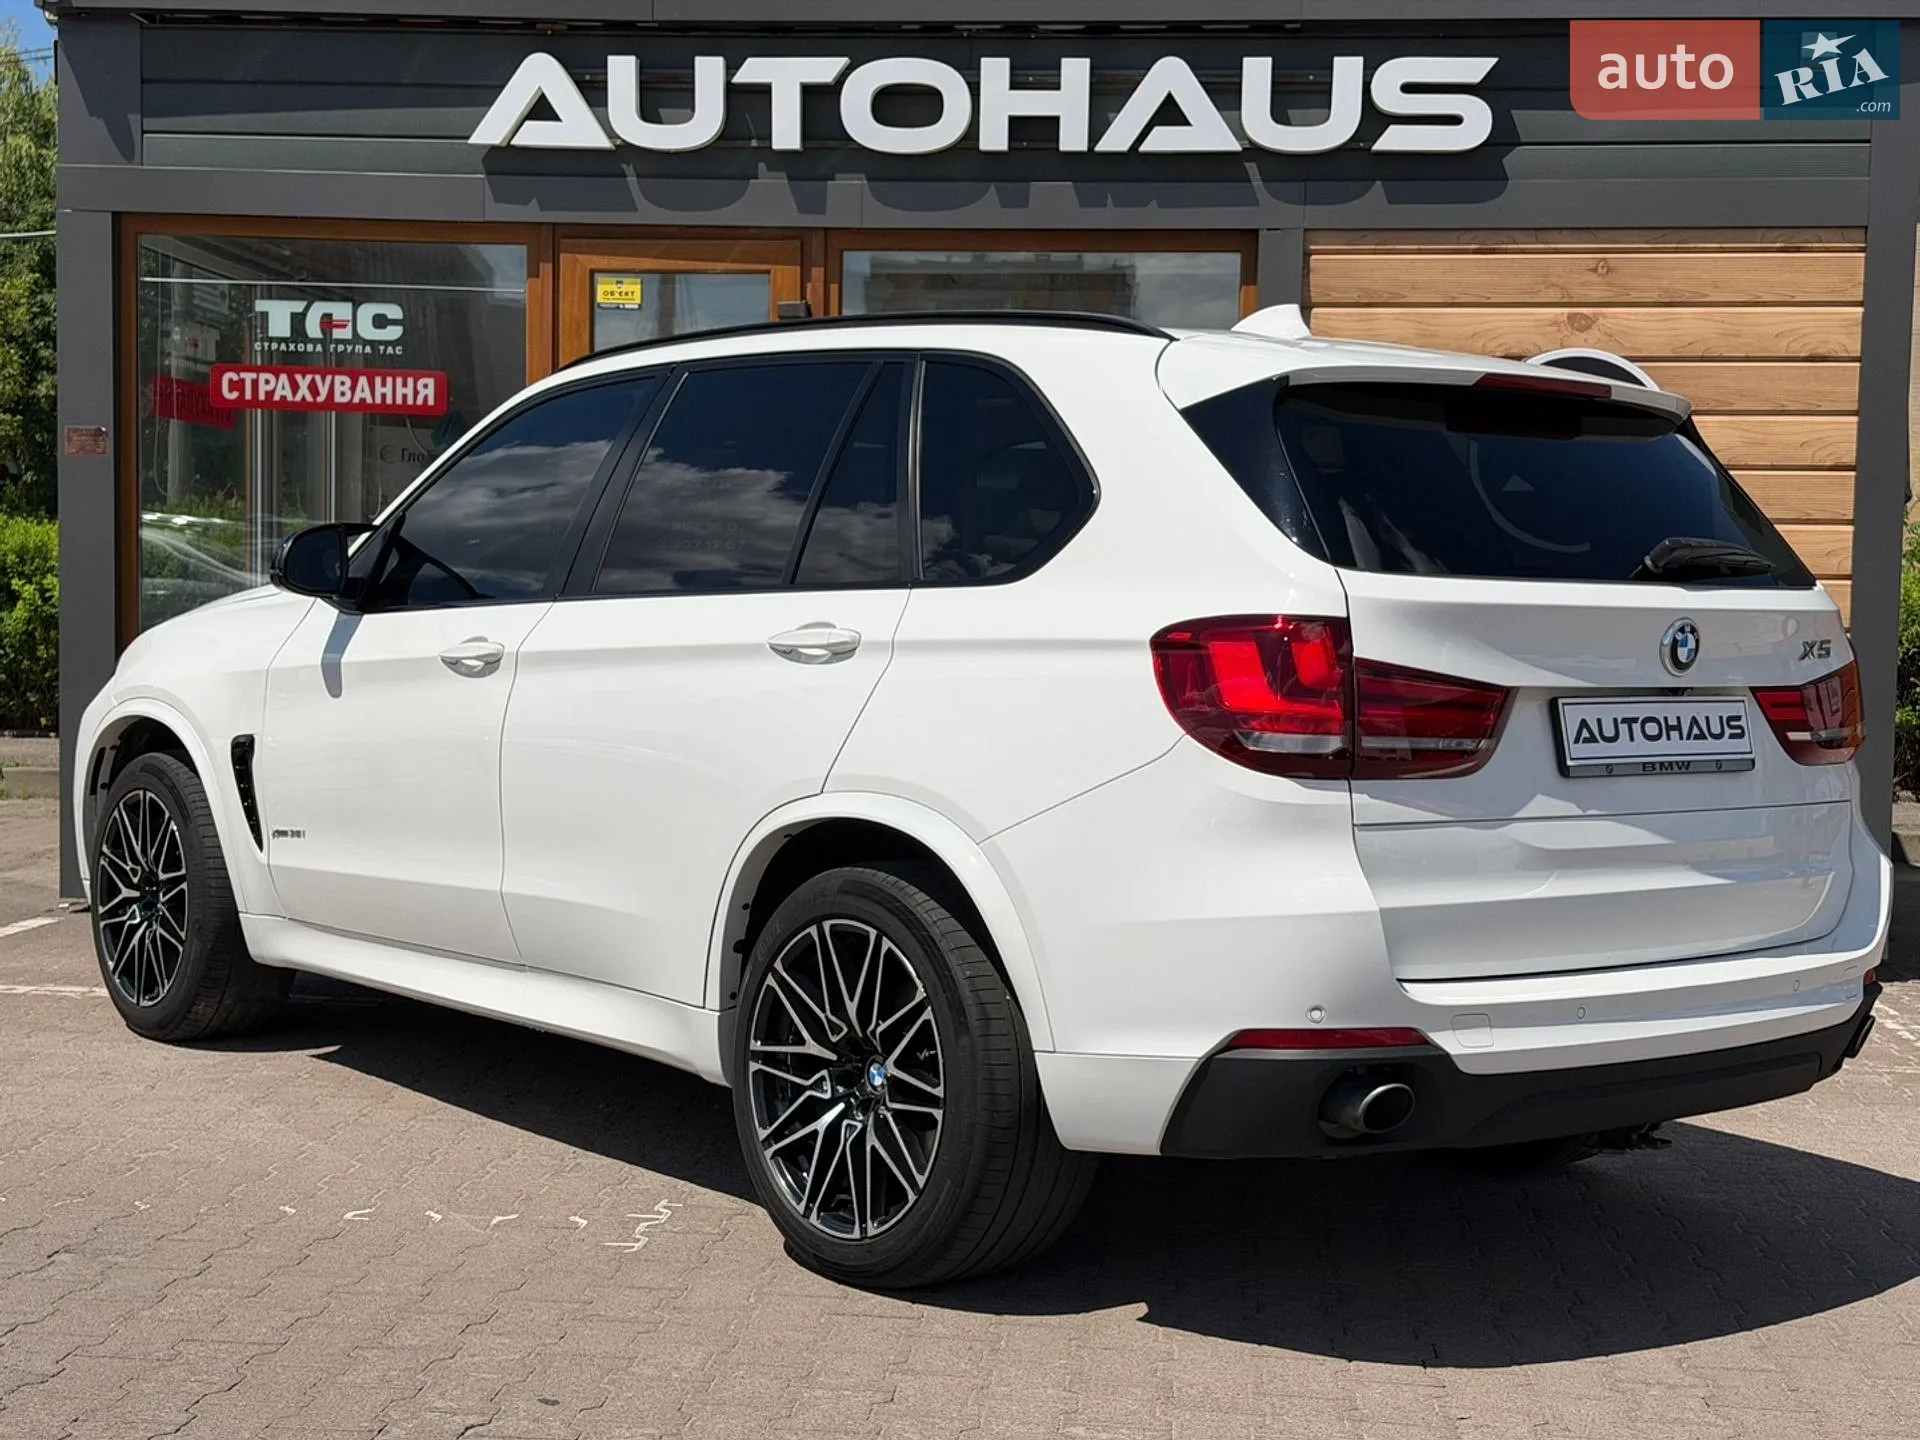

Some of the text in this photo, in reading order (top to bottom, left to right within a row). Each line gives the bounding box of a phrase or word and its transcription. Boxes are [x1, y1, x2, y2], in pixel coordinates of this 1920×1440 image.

[467, 52, 1499, 155] AUTOHAUS
[254, 341, 404, 355] СТРАХОВА ГРУПА ТАС
[221, 371, 436, 406] СТРАХУВАННЯ
[1797, 639, 1831, 661] X5
[1573, 714, 1746, 745] AUTOHAUS
[1641, 760, 1691, 772] BMW
